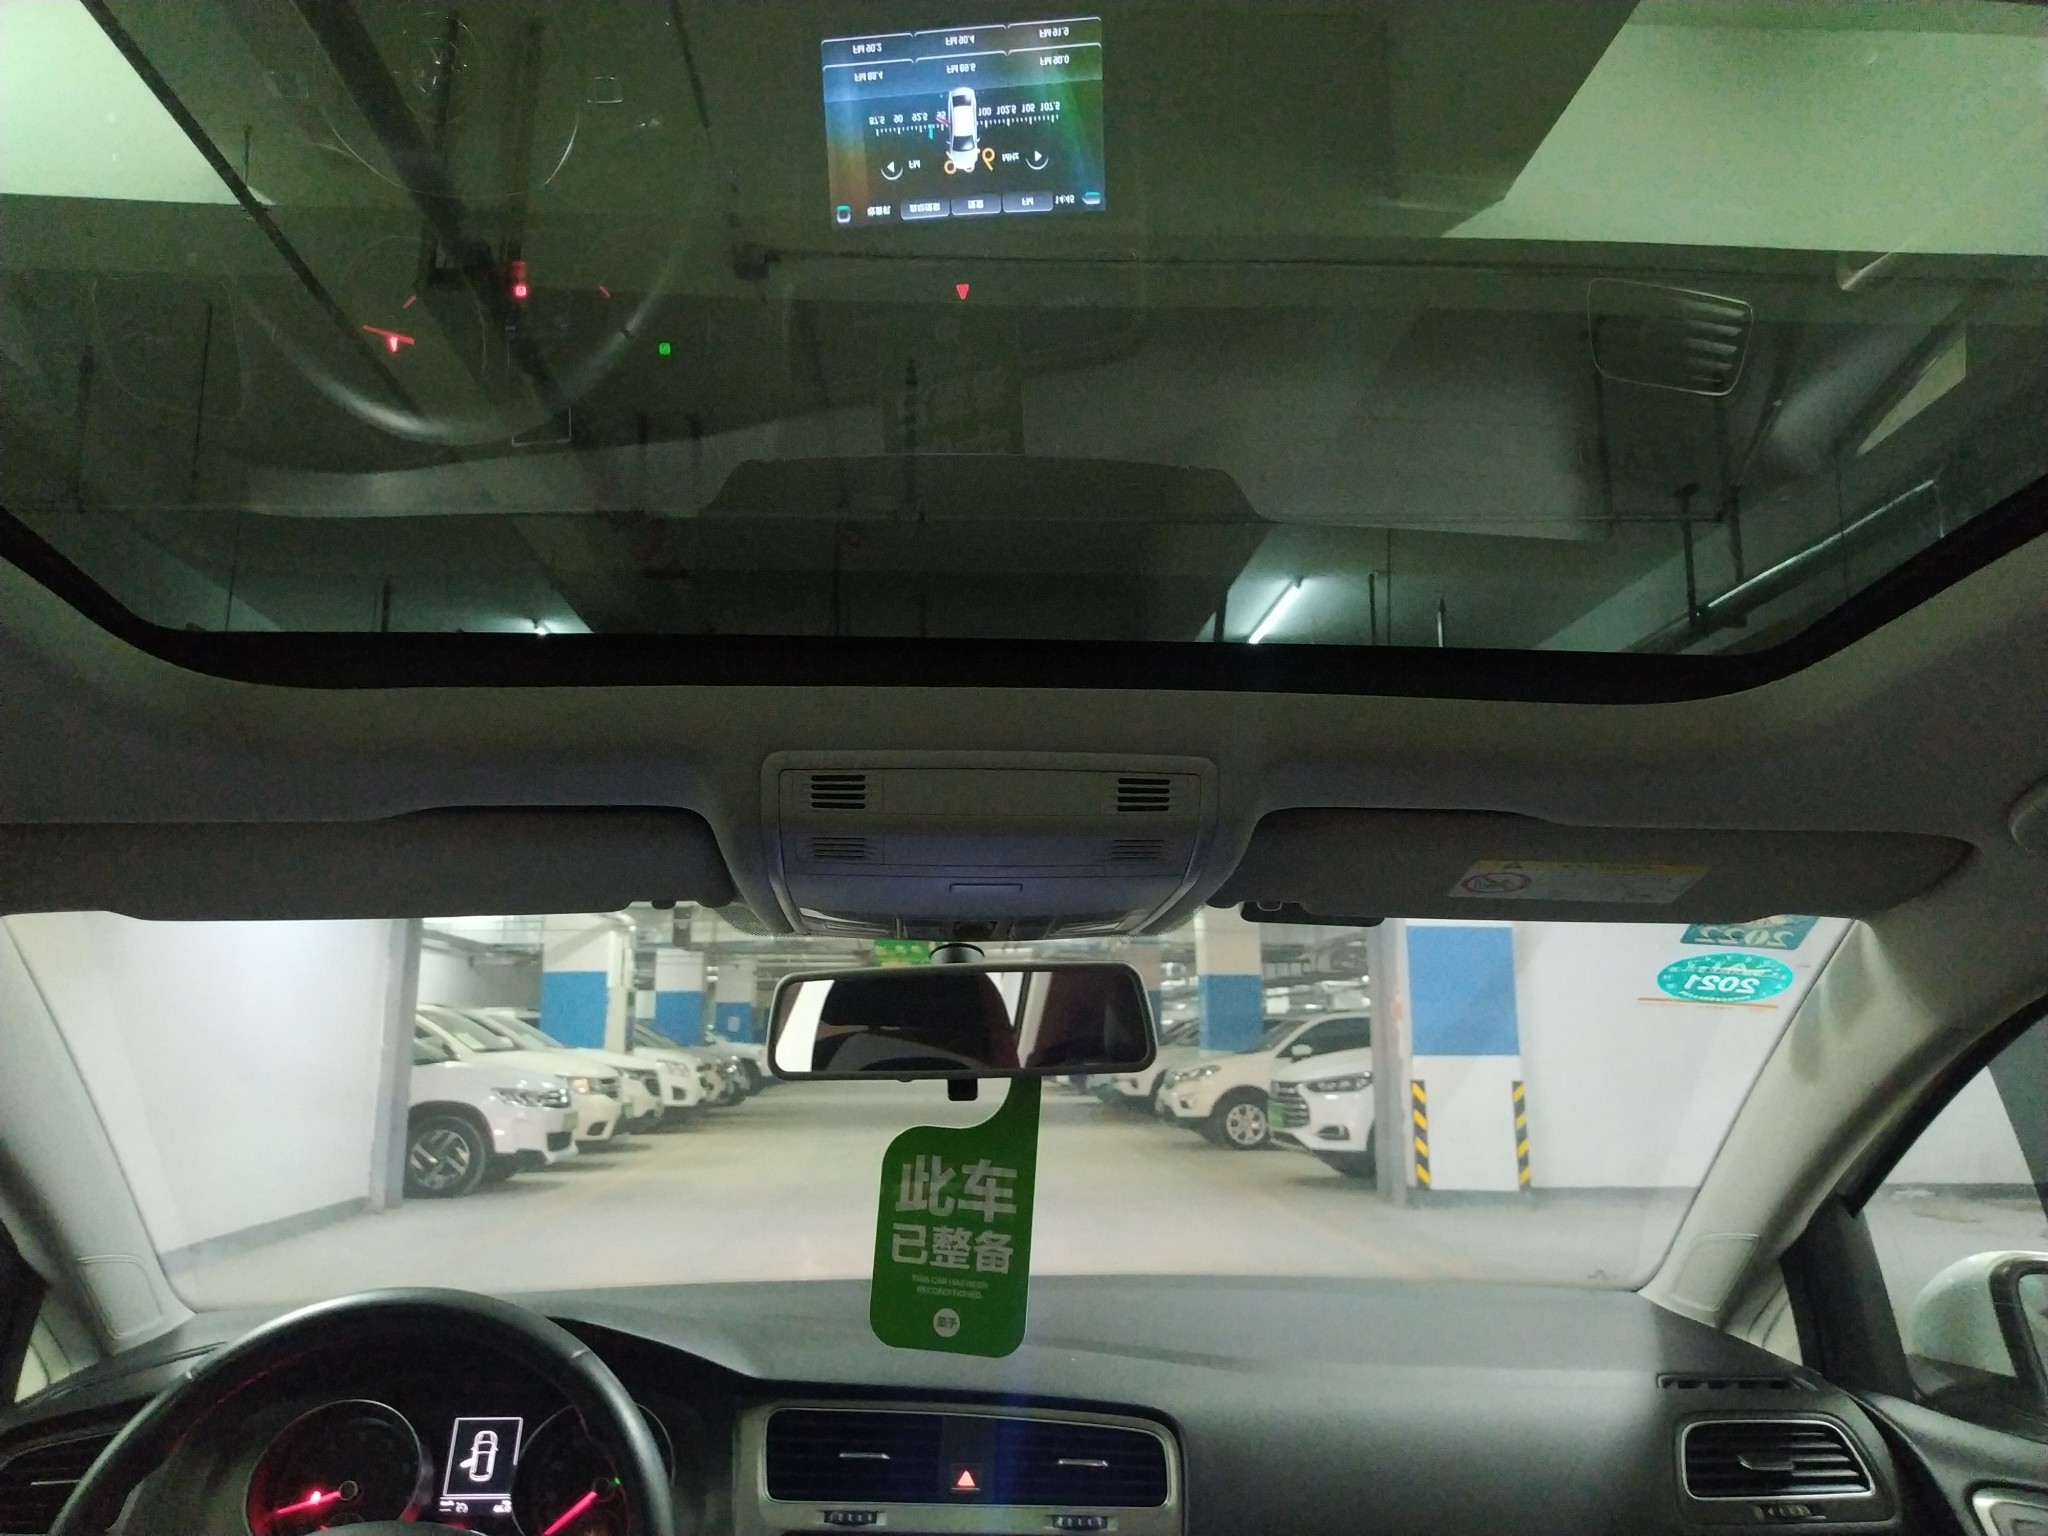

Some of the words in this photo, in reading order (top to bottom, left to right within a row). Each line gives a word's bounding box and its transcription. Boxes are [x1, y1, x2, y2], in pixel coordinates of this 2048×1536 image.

[895, 1155, 1017, 1223] 此车
[892, 1223, 1014, 1275] 已整备
